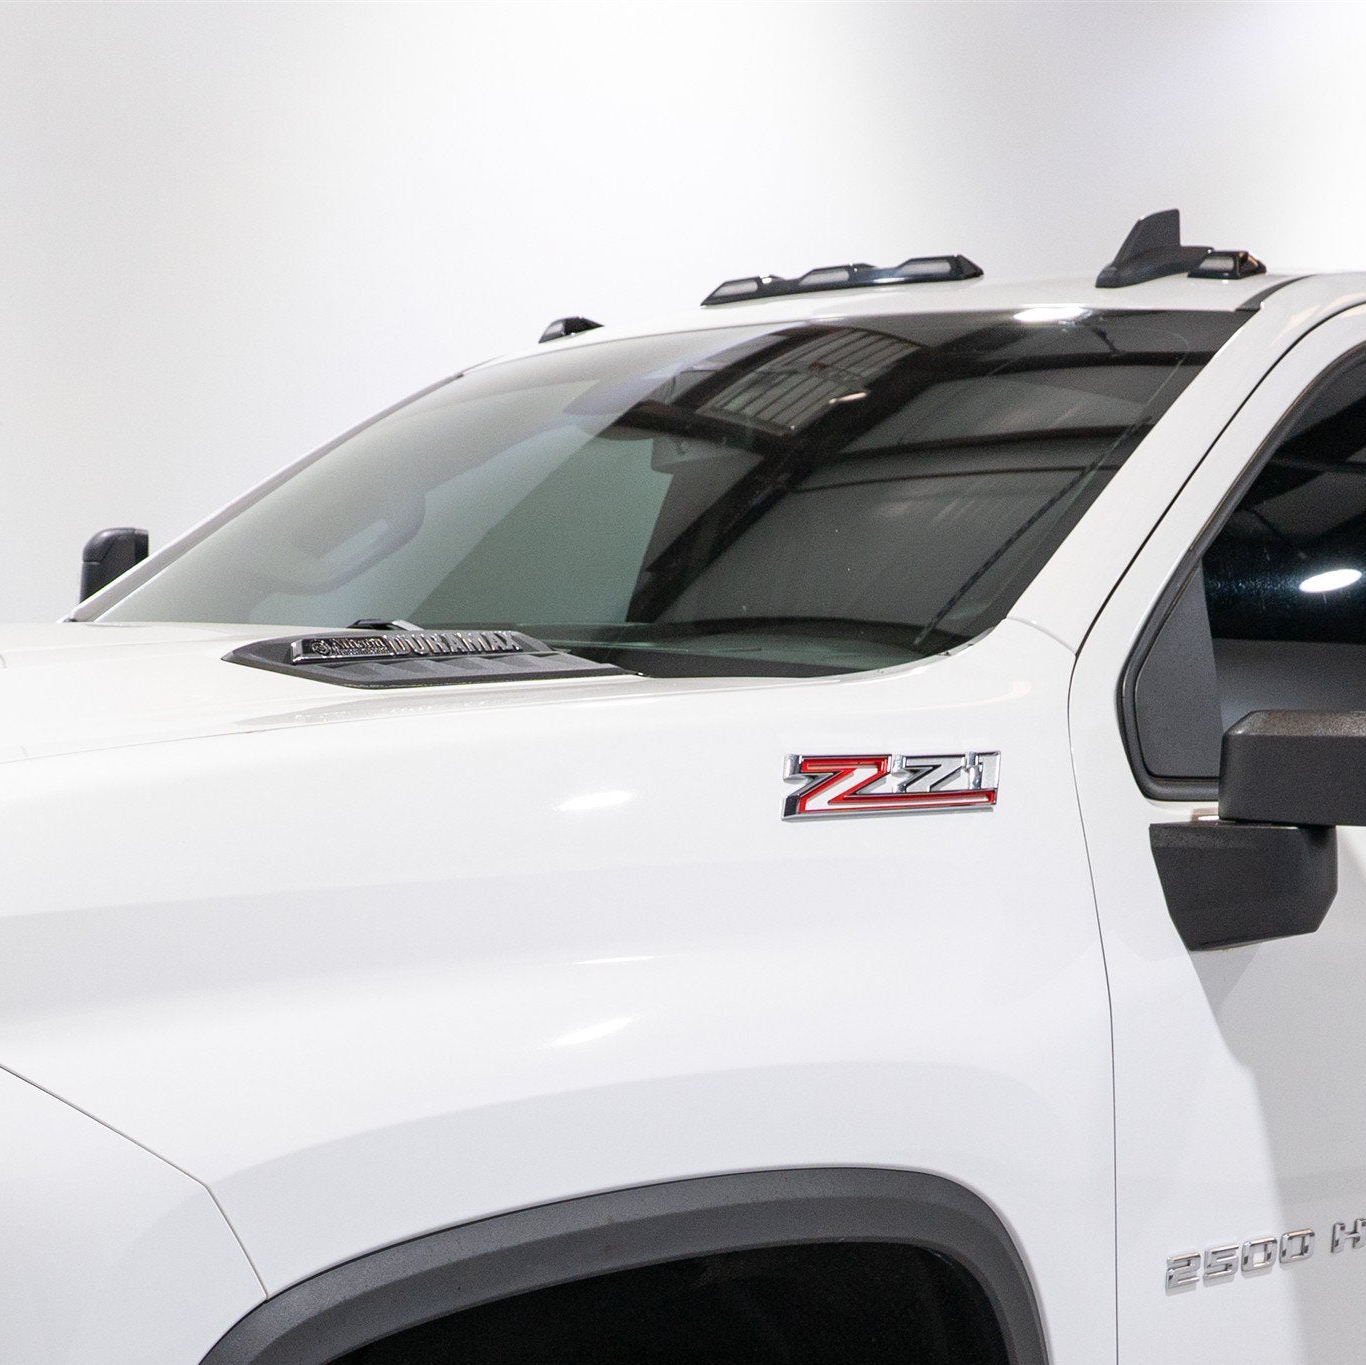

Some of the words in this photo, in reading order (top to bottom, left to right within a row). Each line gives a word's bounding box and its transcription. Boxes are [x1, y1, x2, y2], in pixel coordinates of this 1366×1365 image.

[386, 630, 524, 656] DURAMAX
[781, 750, 1001, 822] Z71
[1165, 1228, 1316, 1288] 2500
